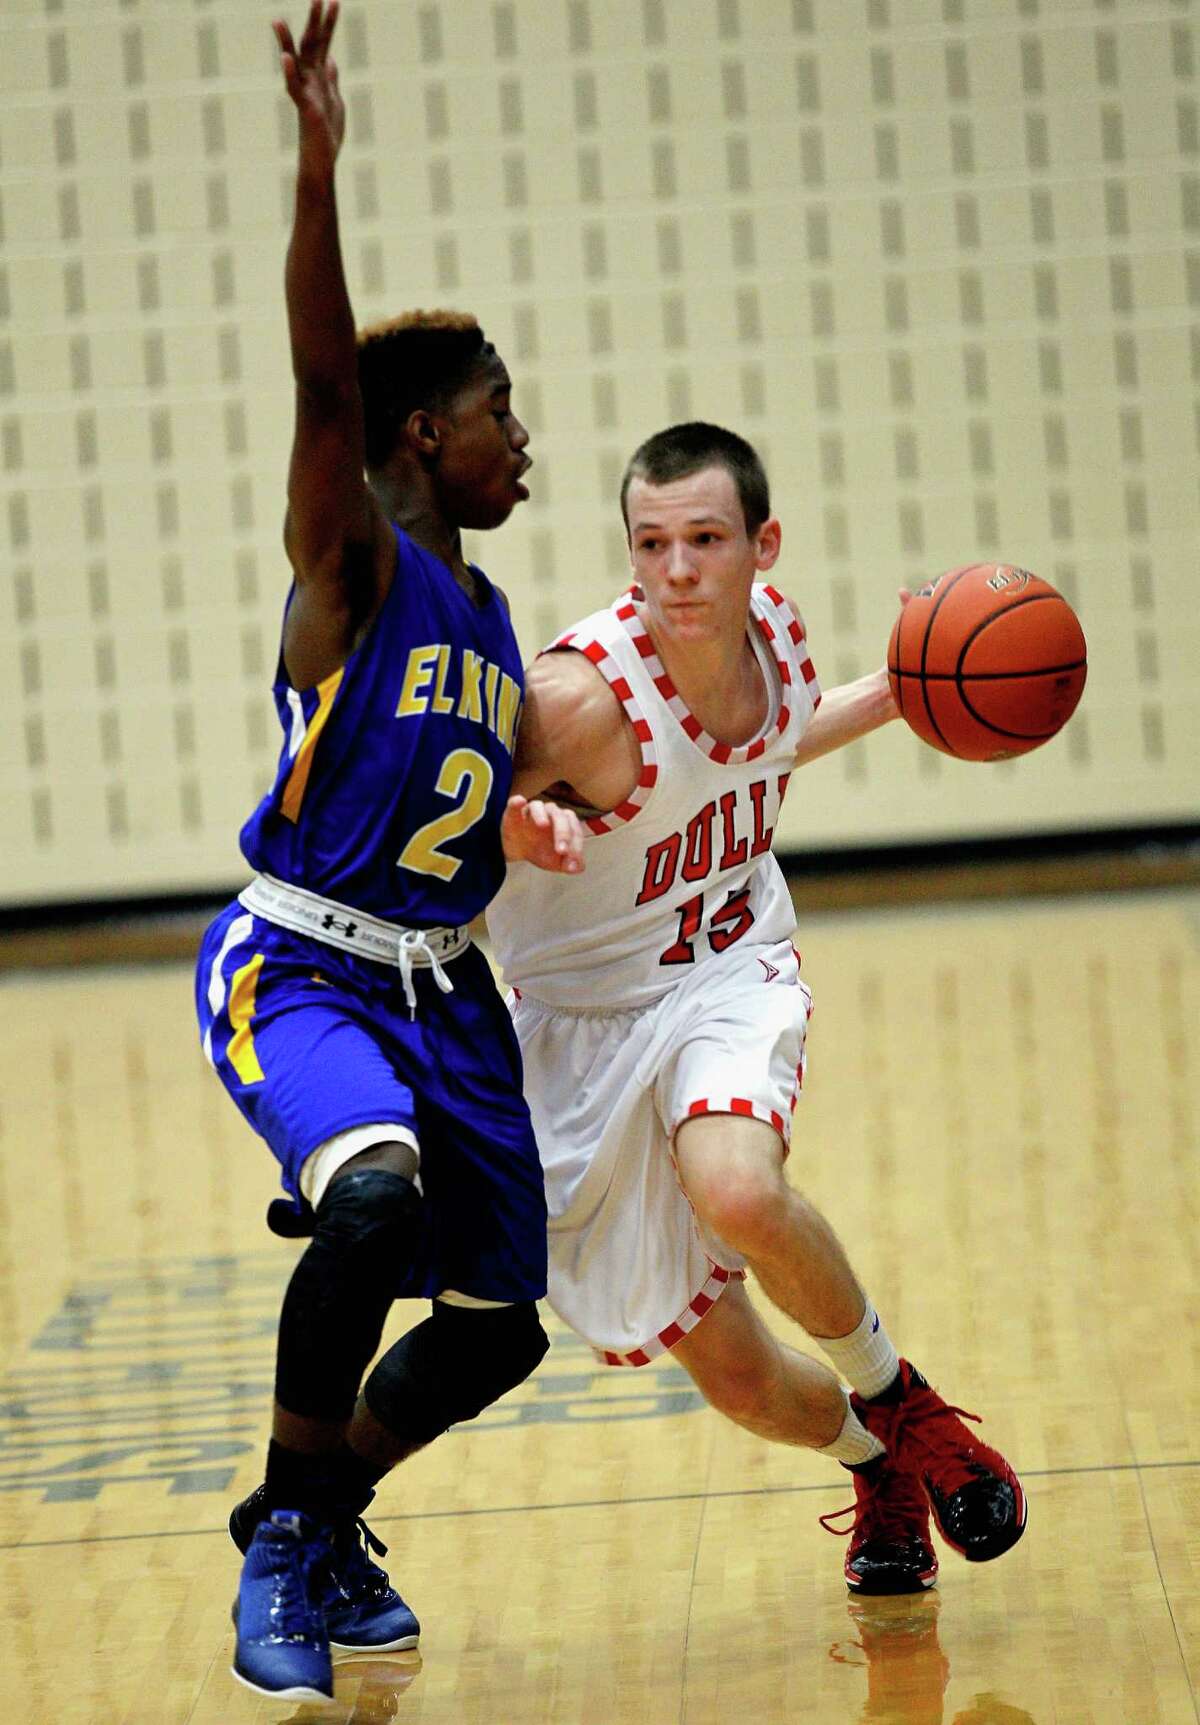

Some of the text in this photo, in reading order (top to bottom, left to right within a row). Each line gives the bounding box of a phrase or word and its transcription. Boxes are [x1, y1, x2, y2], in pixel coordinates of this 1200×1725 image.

[394, 643, 523, 757] ELKIN
[396, 747, 494, 882] 2
[659, 880, 755, 966] 15
